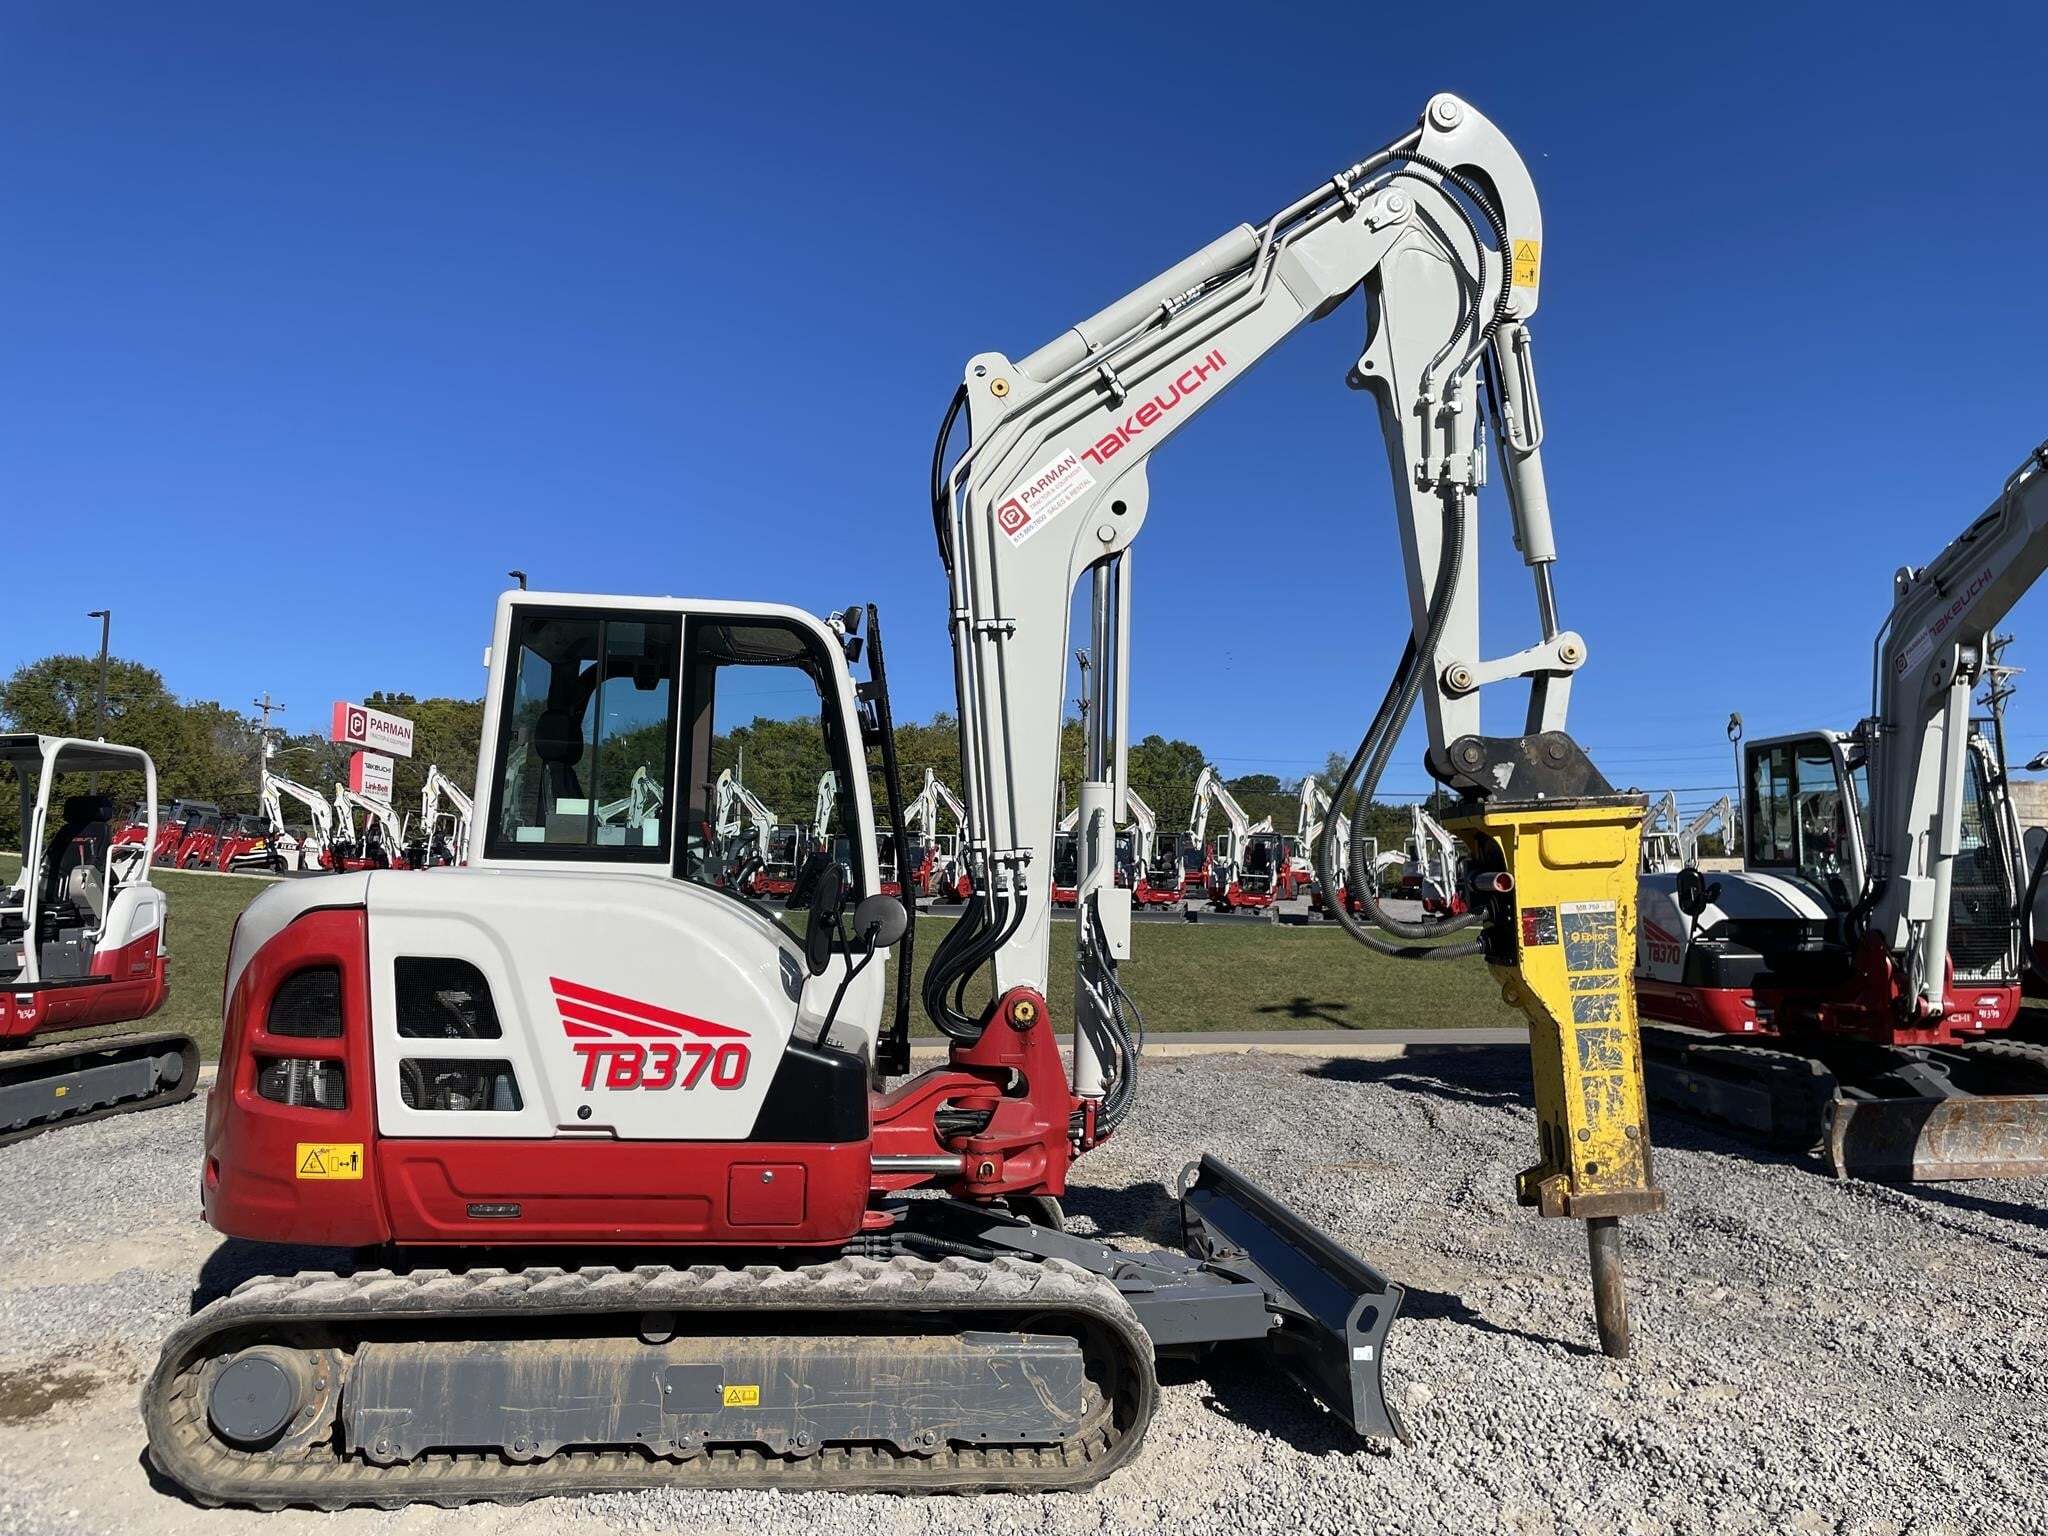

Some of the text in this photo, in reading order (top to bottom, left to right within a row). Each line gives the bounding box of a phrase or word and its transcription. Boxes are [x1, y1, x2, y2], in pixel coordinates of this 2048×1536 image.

[1021, 455, 1077, 503] PARMAN
[370, 717, 411, 740] PARMAN
[365, 782, 389, 793] Link-Belt
[1581, 931, 1609, 941] Epiroc
[1647, 942, 1681, 965] TB370
[573, 1042, 752, 1092] TB370
